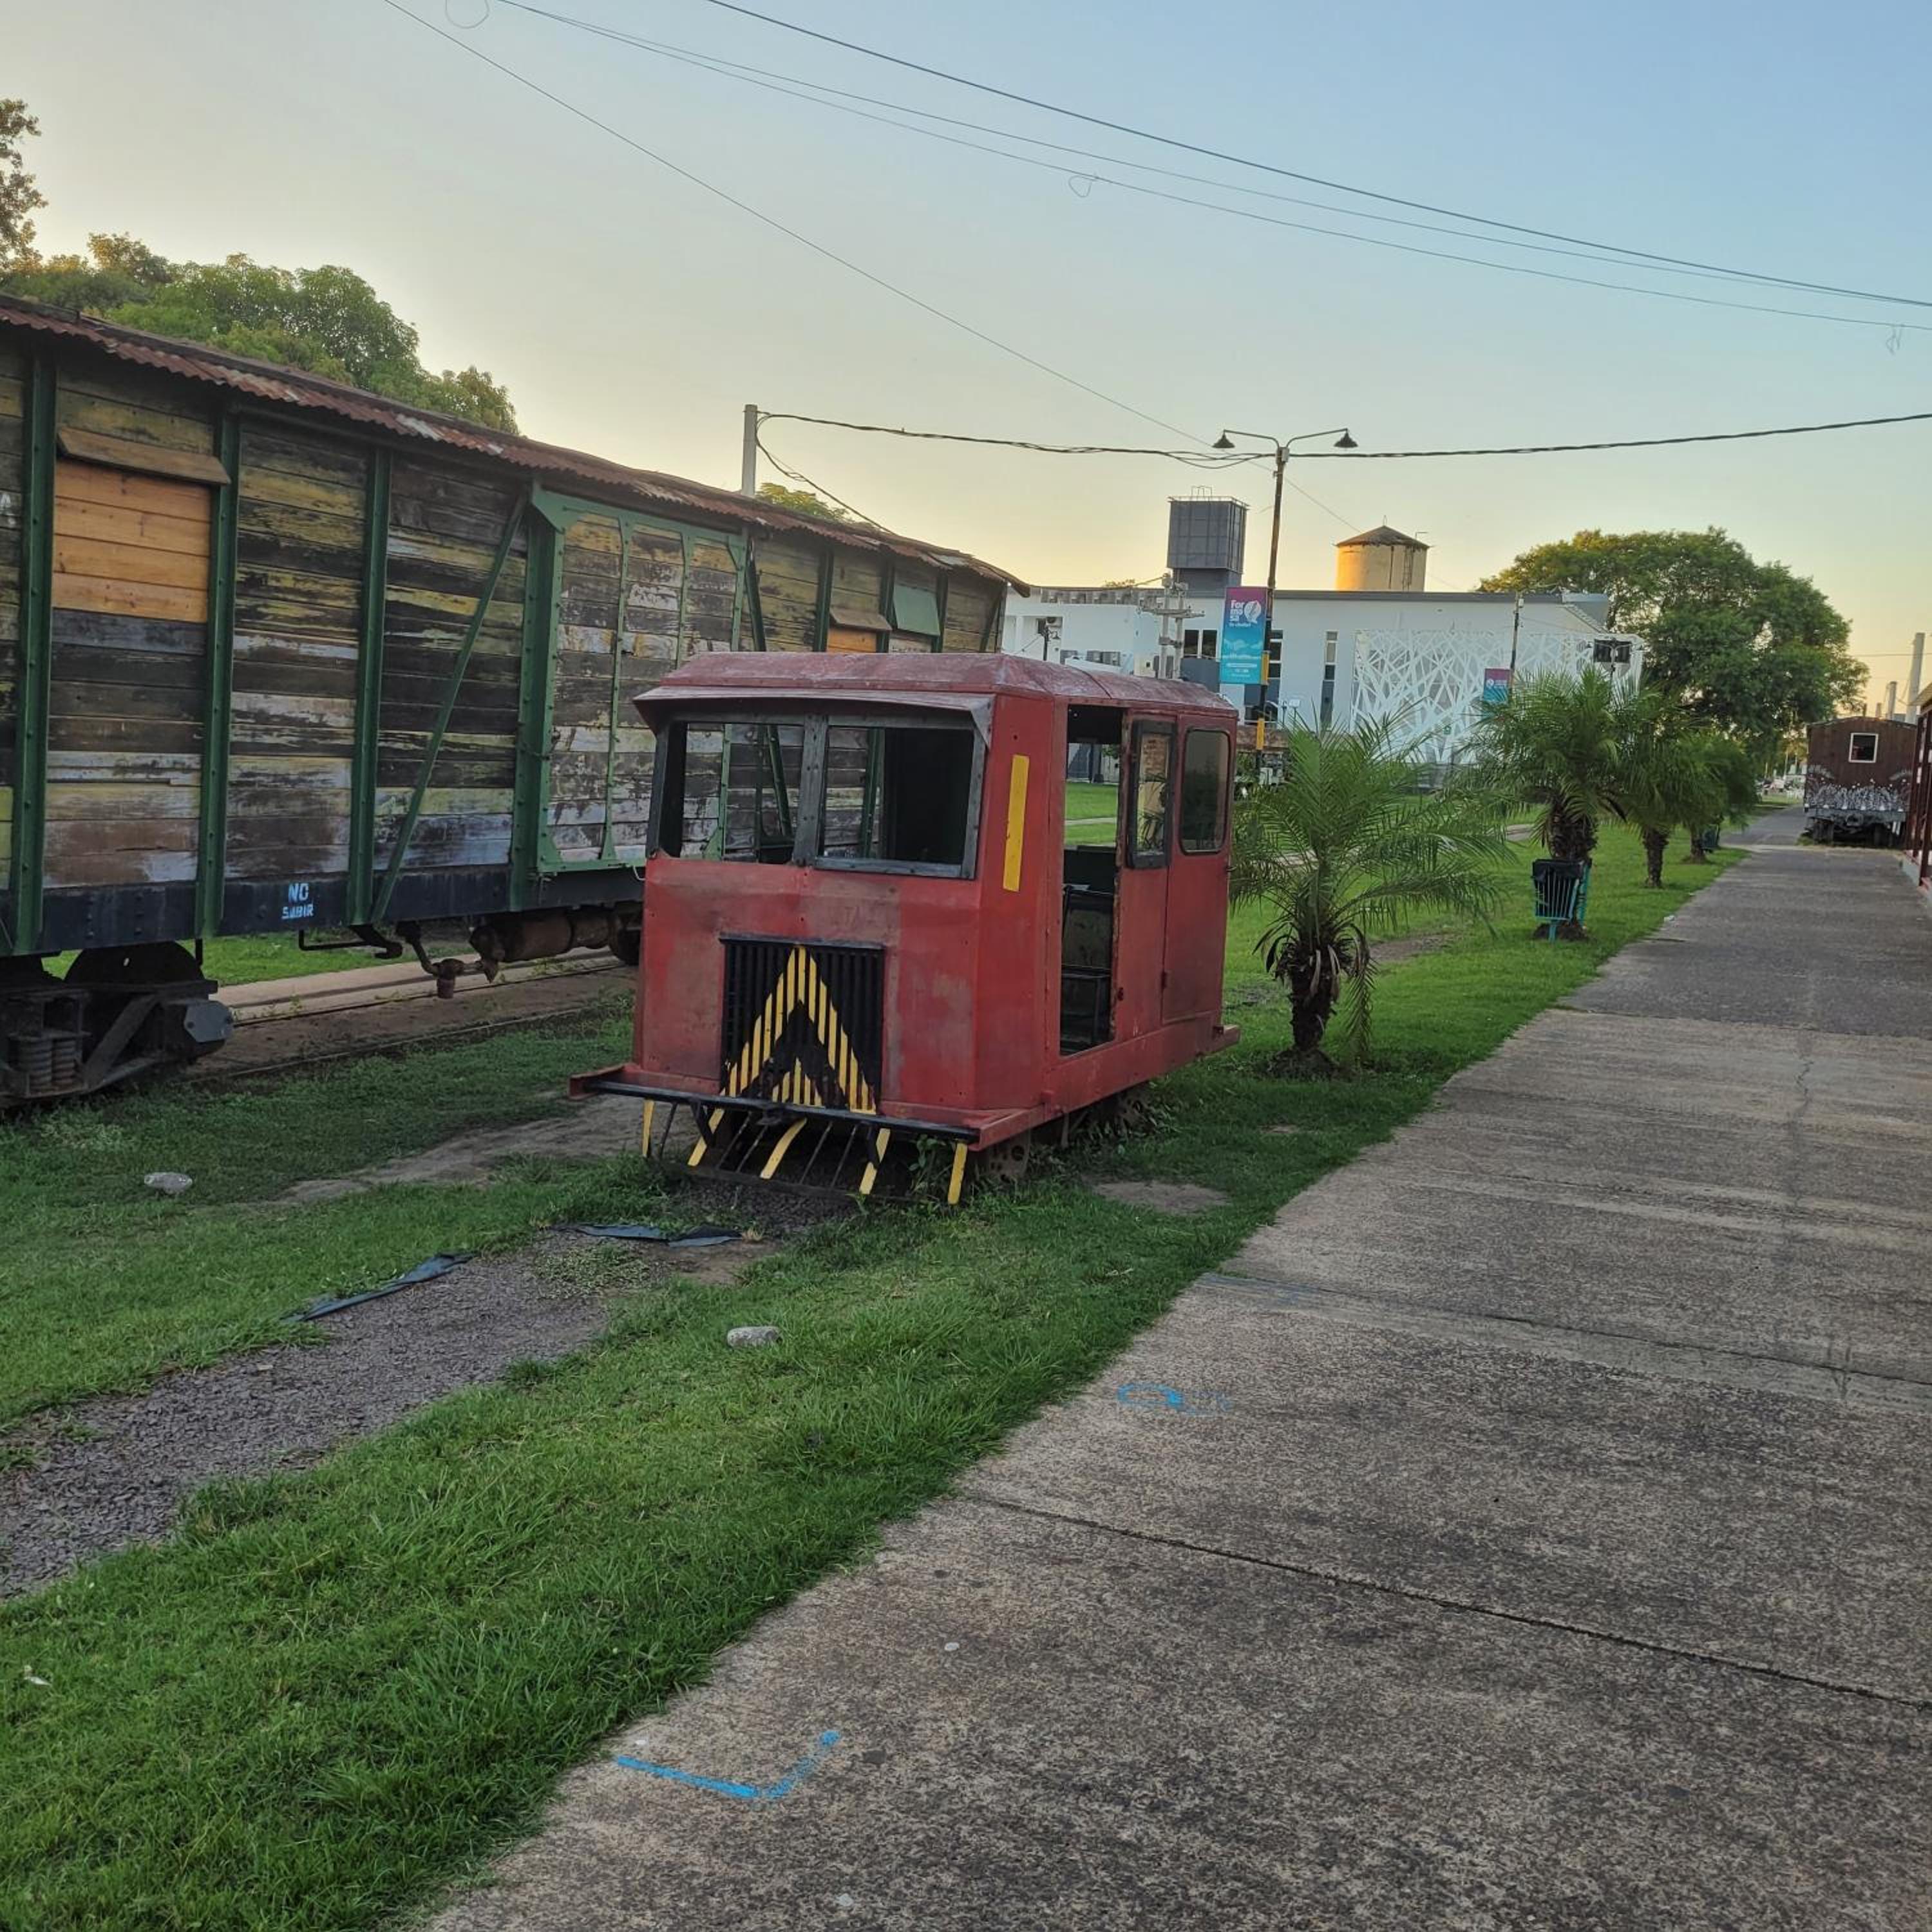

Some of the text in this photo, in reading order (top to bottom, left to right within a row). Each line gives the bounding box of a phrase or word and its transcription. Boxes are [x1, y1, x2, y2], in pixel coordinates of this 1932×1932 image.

[1231, 600, 1245, 609] For
[289, 883, 309, 902] NO
[281, 904, 314, 920] SUBIR
